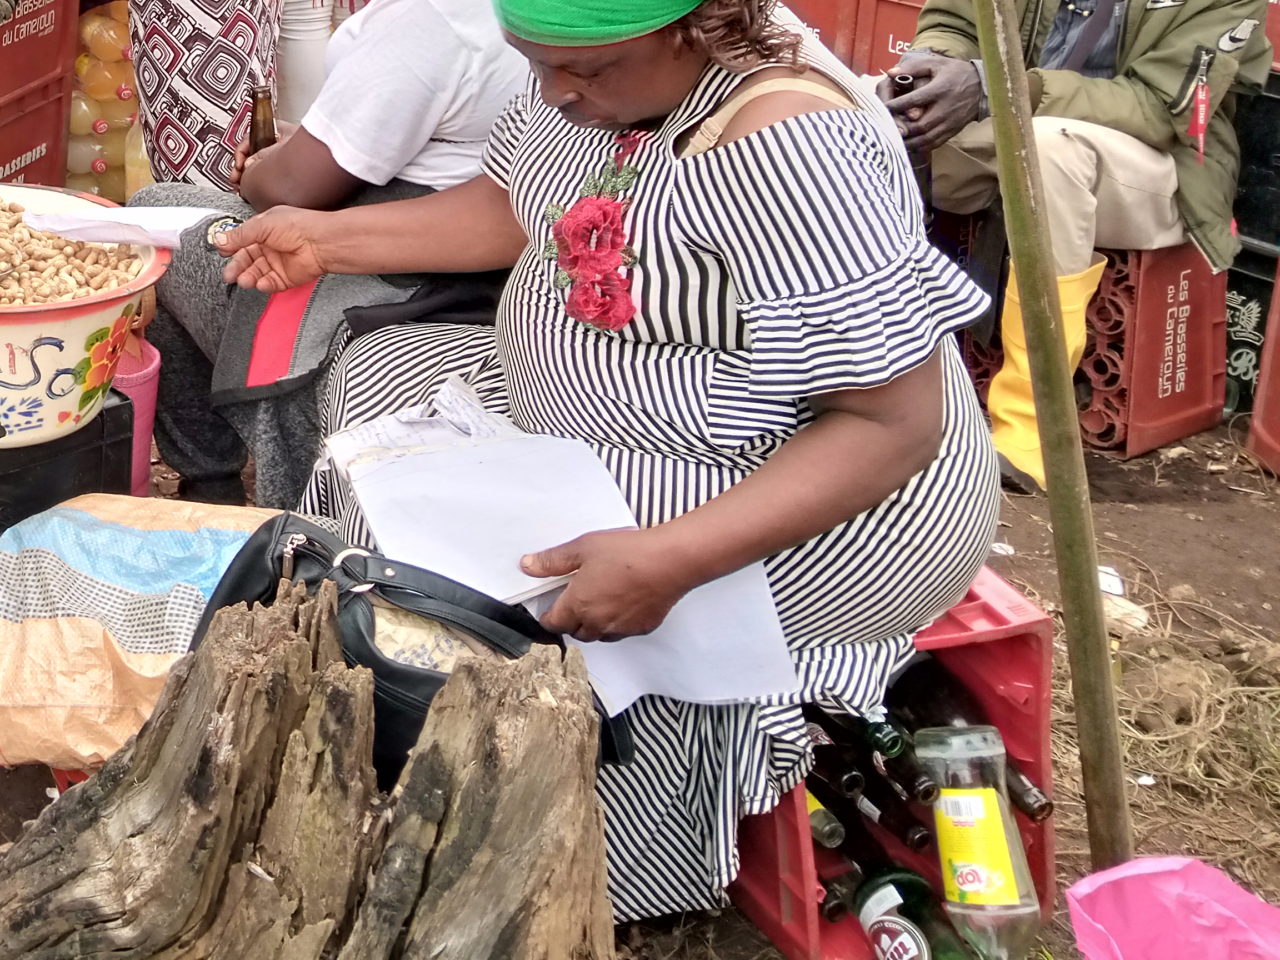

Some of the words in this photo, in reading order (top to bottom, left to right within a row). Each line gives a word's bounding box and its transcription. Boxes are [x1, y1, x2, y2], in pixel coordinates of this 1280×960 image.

[2, 29, 13, 46] du
[14, 9, 55, 42] Cameroun
[1167, 285, 1176, 303] du
[1178, 268, 1192, 302] Les
[1162, 306, 1178, 398] Cameroun
[1175, 305, 1191, 393] Brasseries
